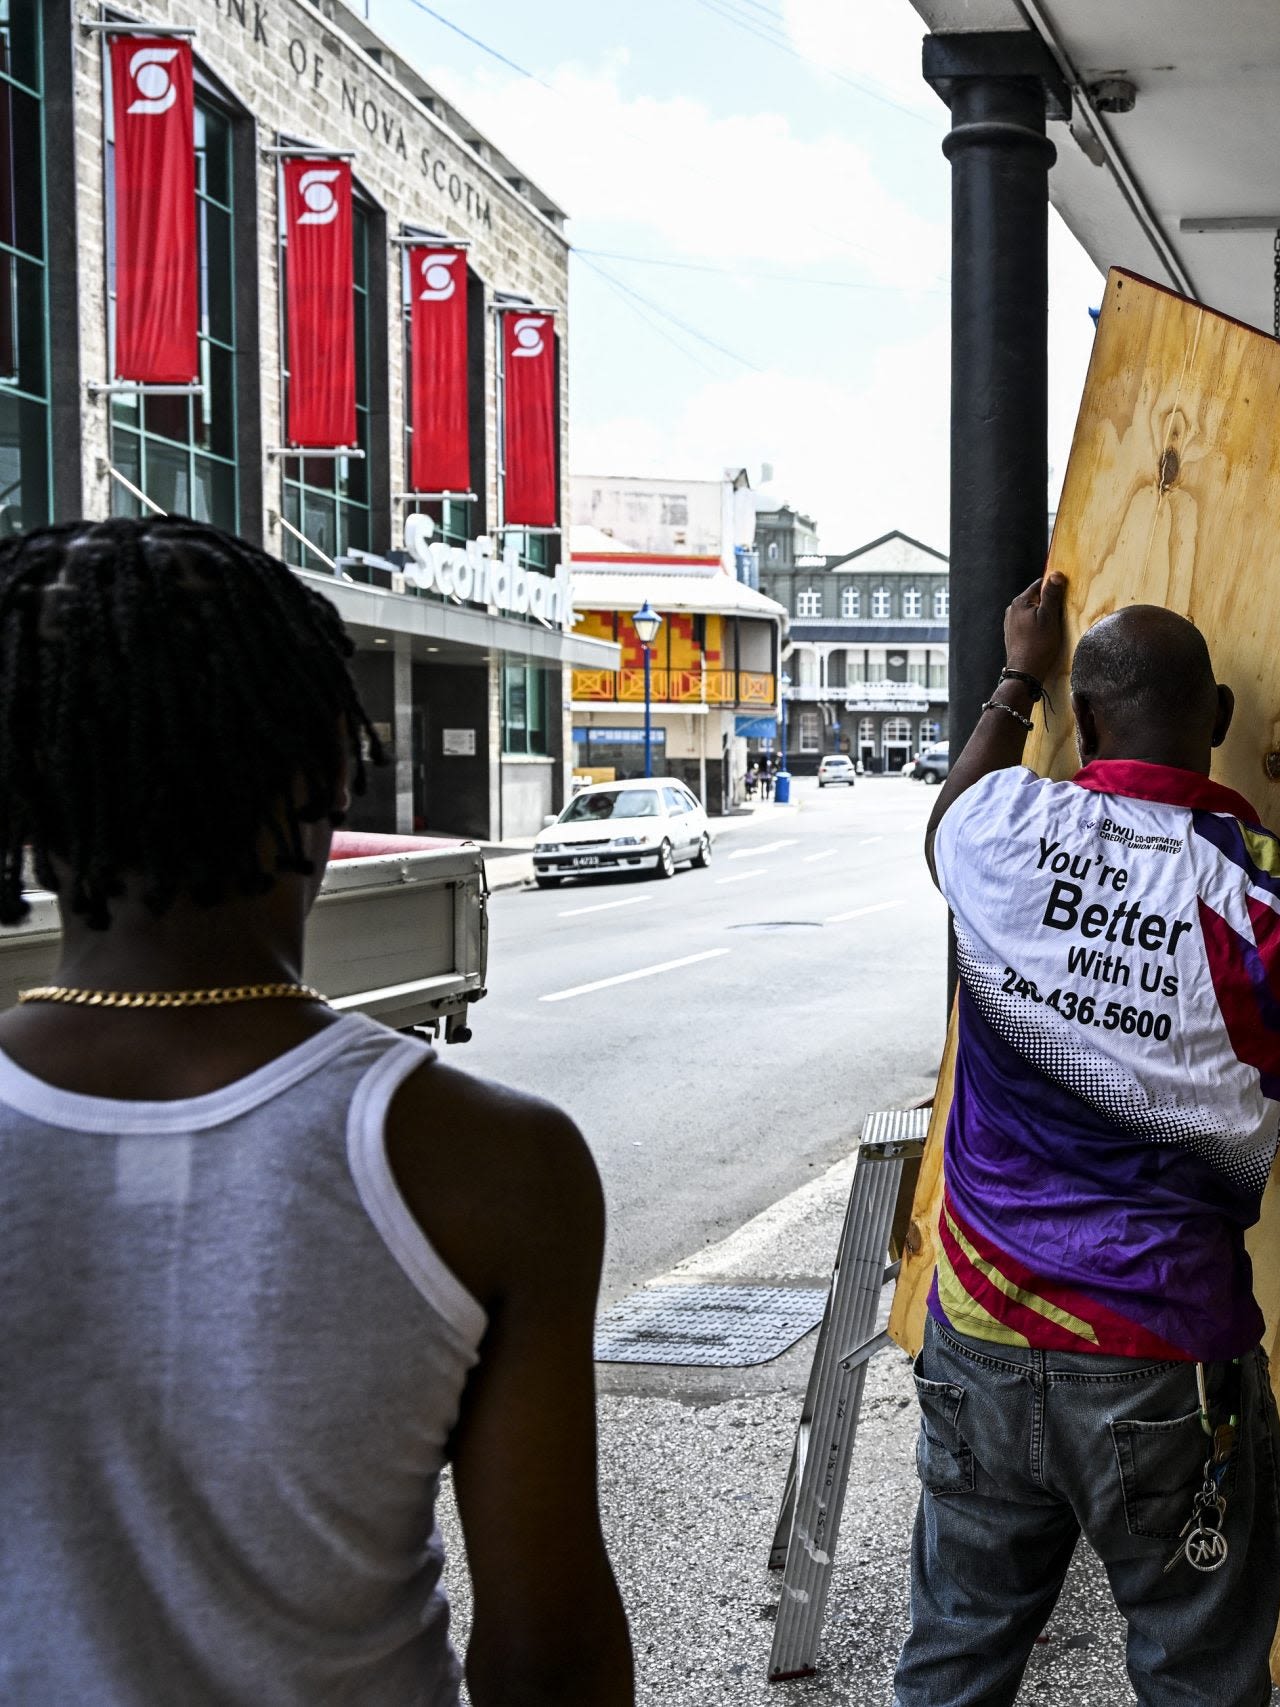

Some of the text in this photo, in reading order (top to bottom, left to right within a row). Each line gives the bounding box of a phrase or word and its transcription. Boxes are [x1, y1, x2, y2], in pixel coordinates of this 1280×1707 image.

[215, 0, 492, 230] NK OF NOVA SCOTIA
[403, 513, 584, 627] Scotiabank
[1099, 831, 1129, 845] CREDIT
[1128, 841, 1154, 850] UNION
[1101, 818, 1135, 841] BWU
[1042, 878, 1193, 957] Better
[1001, 966, 1172, 1042] 246436.5600
[1067, 945, 1179, 997] With Us
